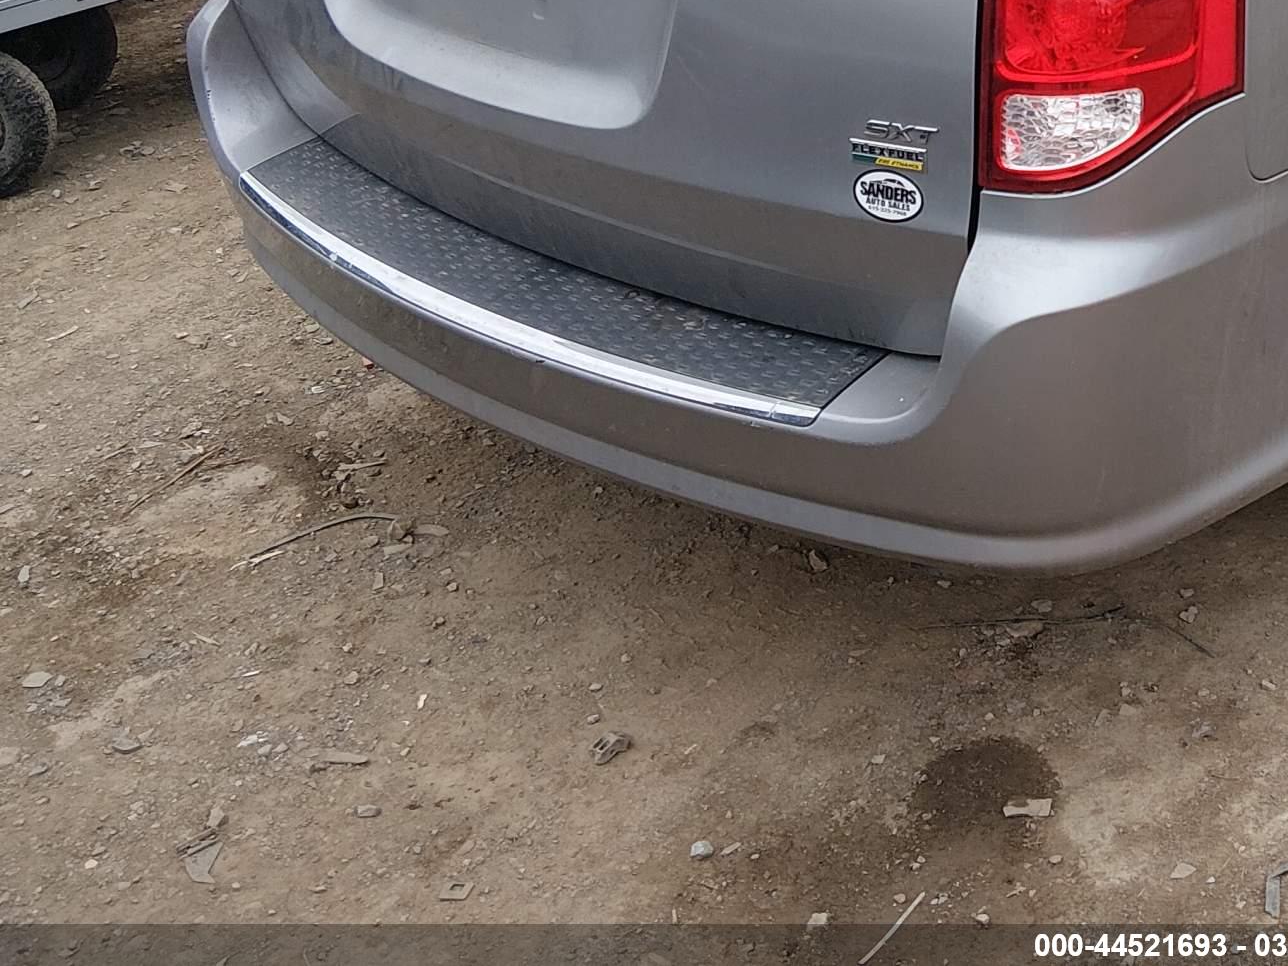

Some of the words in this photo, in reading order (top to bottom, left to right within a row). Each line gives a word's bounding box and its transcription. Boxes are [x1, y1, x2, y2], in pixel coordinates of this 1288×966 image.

[863, 119, 940, 145] SXT
[851, 143, 924, 162] FLEXFUEL
[860, 181, 917, 205] SANDERS
[866, 196, 886, 207] AUTO
[888, 201, 910, 212] SALES
